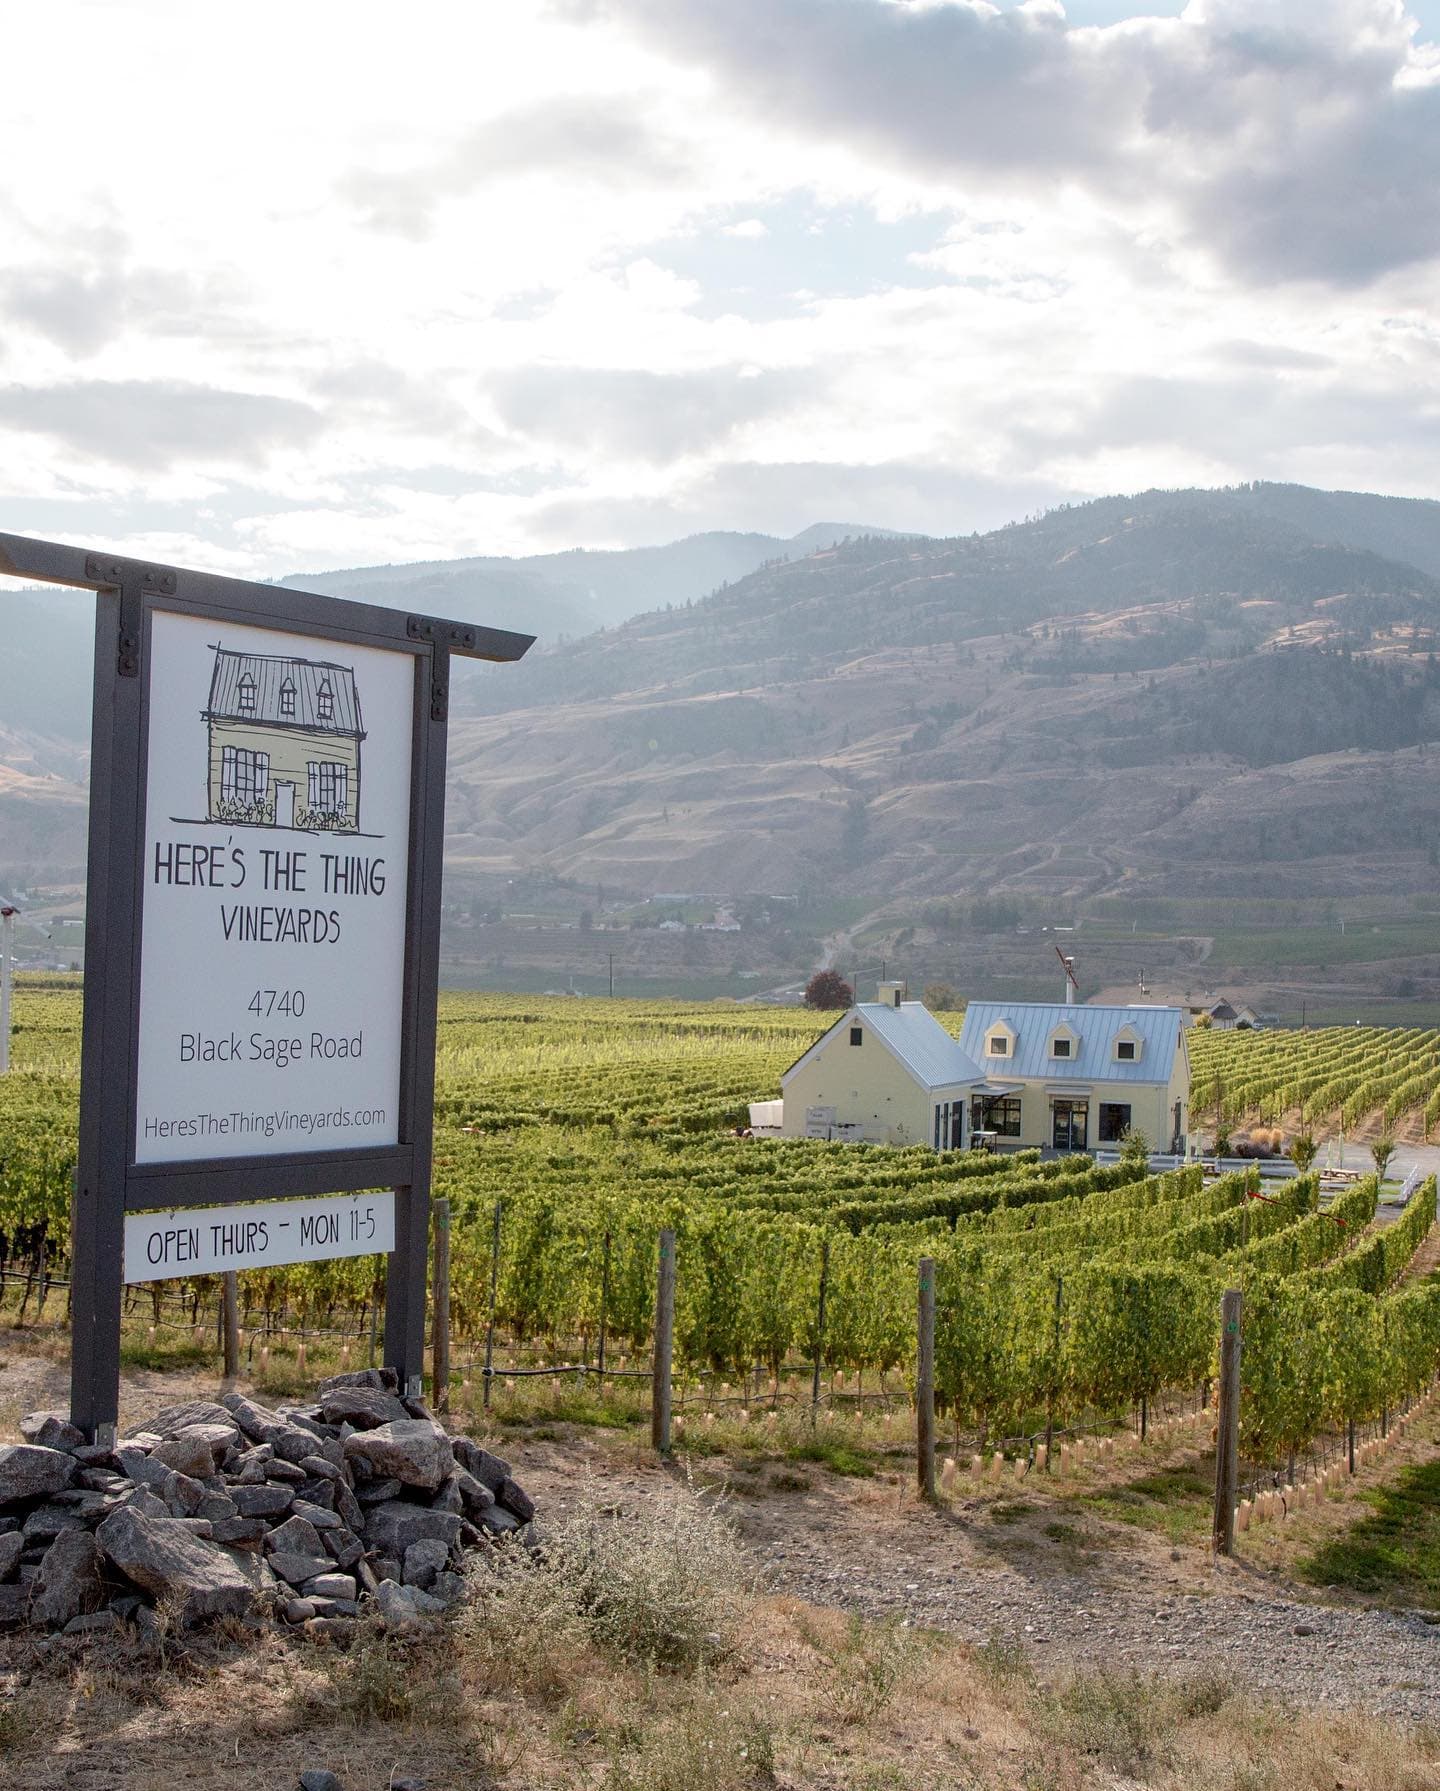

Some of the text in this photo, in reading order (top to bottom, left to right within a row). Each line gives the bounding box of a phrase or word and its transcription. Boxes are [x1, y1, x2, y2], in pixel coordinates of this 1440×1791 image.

[155, 836, 385, 895] HERE'S THE THING
[221, 905, 340, 943] VINEYARDS
[248, 991, 305, 1017] 4740
[181, 1031, 362, 1067] Black Sage Road
[145, 1108, 385, 1138] HeresTheThingVineyards.com
[147, 1228, 199, 1264] OPEN
[210, 1221, 268, 1256] THURS
[301, 1213, 339, 1247] MON
[350, 1208, 375, 1241] 11-5
